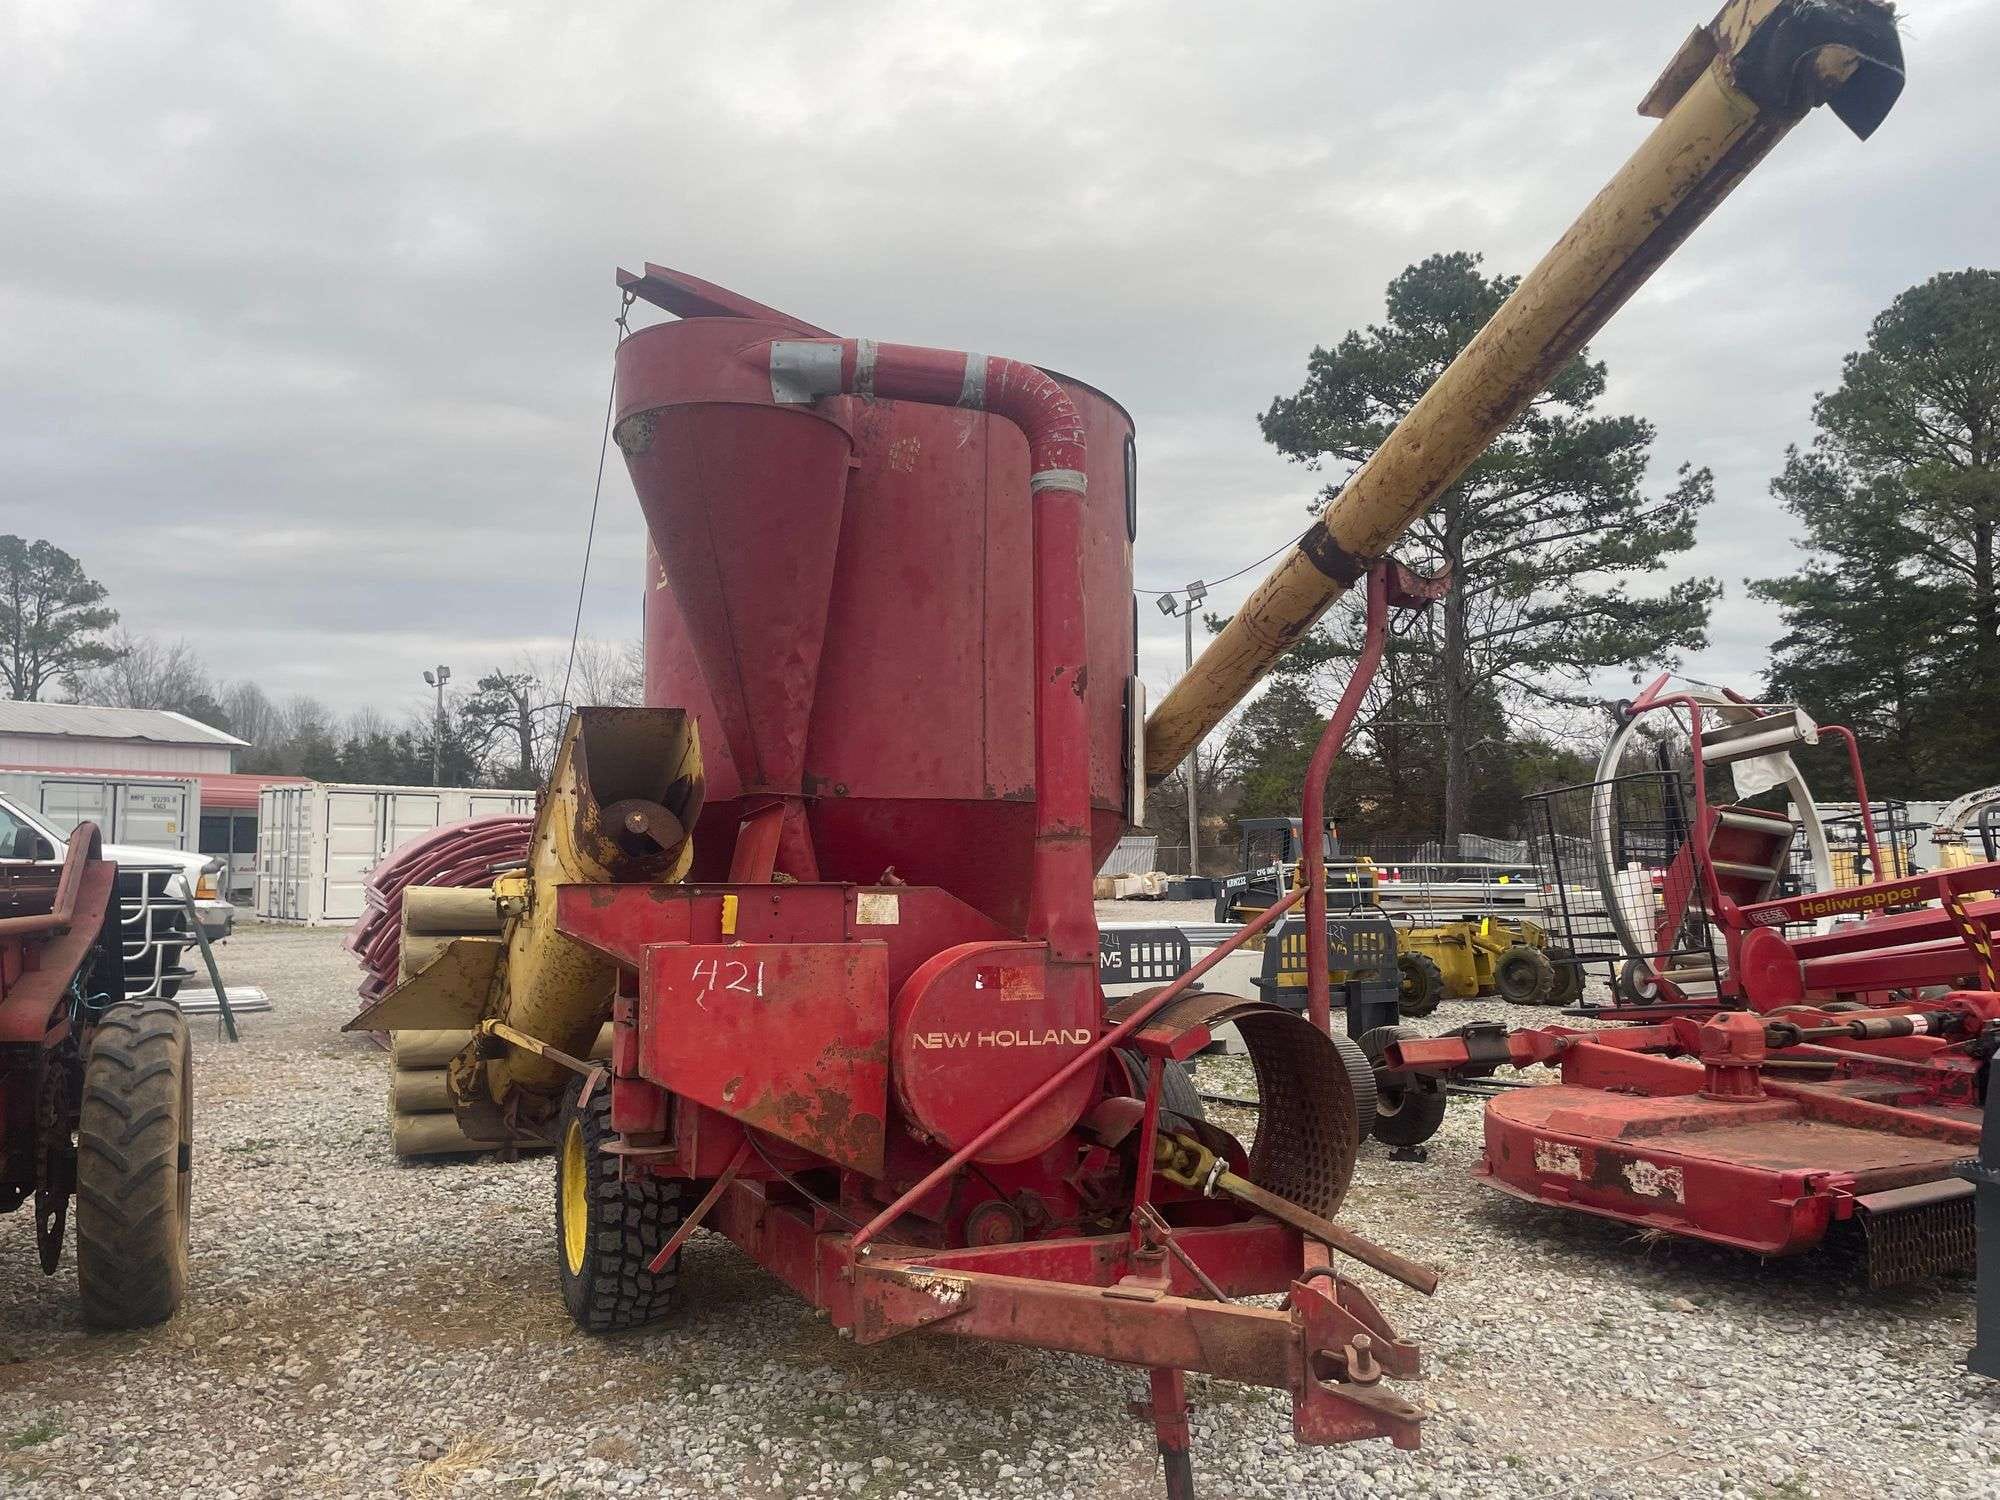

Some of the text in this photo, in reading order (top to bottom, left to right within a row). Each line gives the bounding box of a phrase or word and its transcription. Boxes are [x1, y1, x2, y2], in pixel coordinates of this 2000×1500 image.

[1799, 885, 1921, 916] Heliwrapper
[691, 959, 764, 997] 421
[912, 1028, 1092, 1049] NEW HOLLAND
